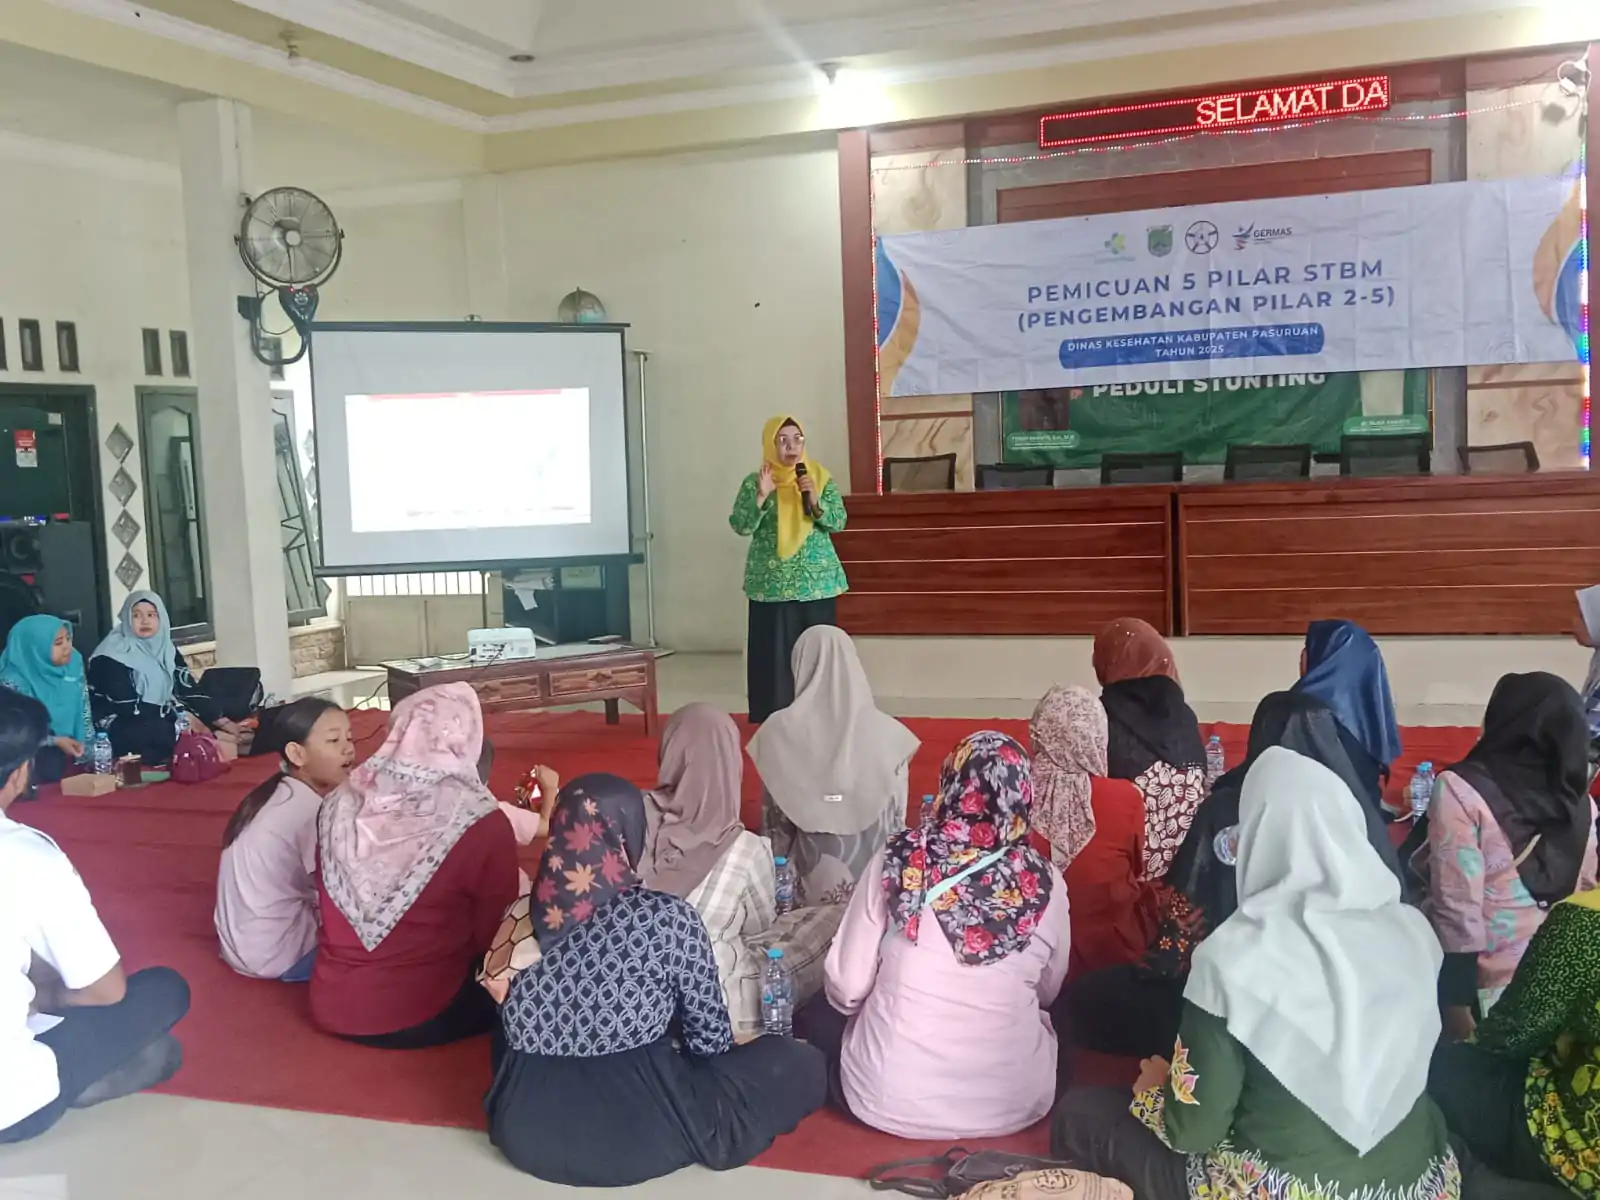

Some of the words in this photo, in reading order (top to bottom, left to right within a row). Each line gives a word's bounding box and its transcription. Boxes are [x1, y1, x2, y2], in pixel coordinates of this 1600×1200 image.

[1196, 86, 1333, 125] SELAMAT
[1341, 81, 1385, 108] DA
[1253, 227, 1293, 238] GERMAS
[1028, 276, 1170, 302] PEMICUAN
[1182, 273, 1196, 291] 5
[1208, 266, 1291, 288] PILAR
[1303, 260, 1383, 282] STBM
[1018, 297, 1241, 332] (PENGEMBANGAN
[1254, 290, 1332, 312] PILAR
[1344, 286, 1396, 308] 2-5)
[1067, 340, 1103, 352] DINAS
[1105, 333, 1174, 349] KESEHATAN
[1177, 330, 1248, 344] KABUPATEN
[1251, 326, 1319, 339] PASURUAN
[1155, 346, 1195, 358] TAHUN
[1198, 344, 1225, 356] 2025
